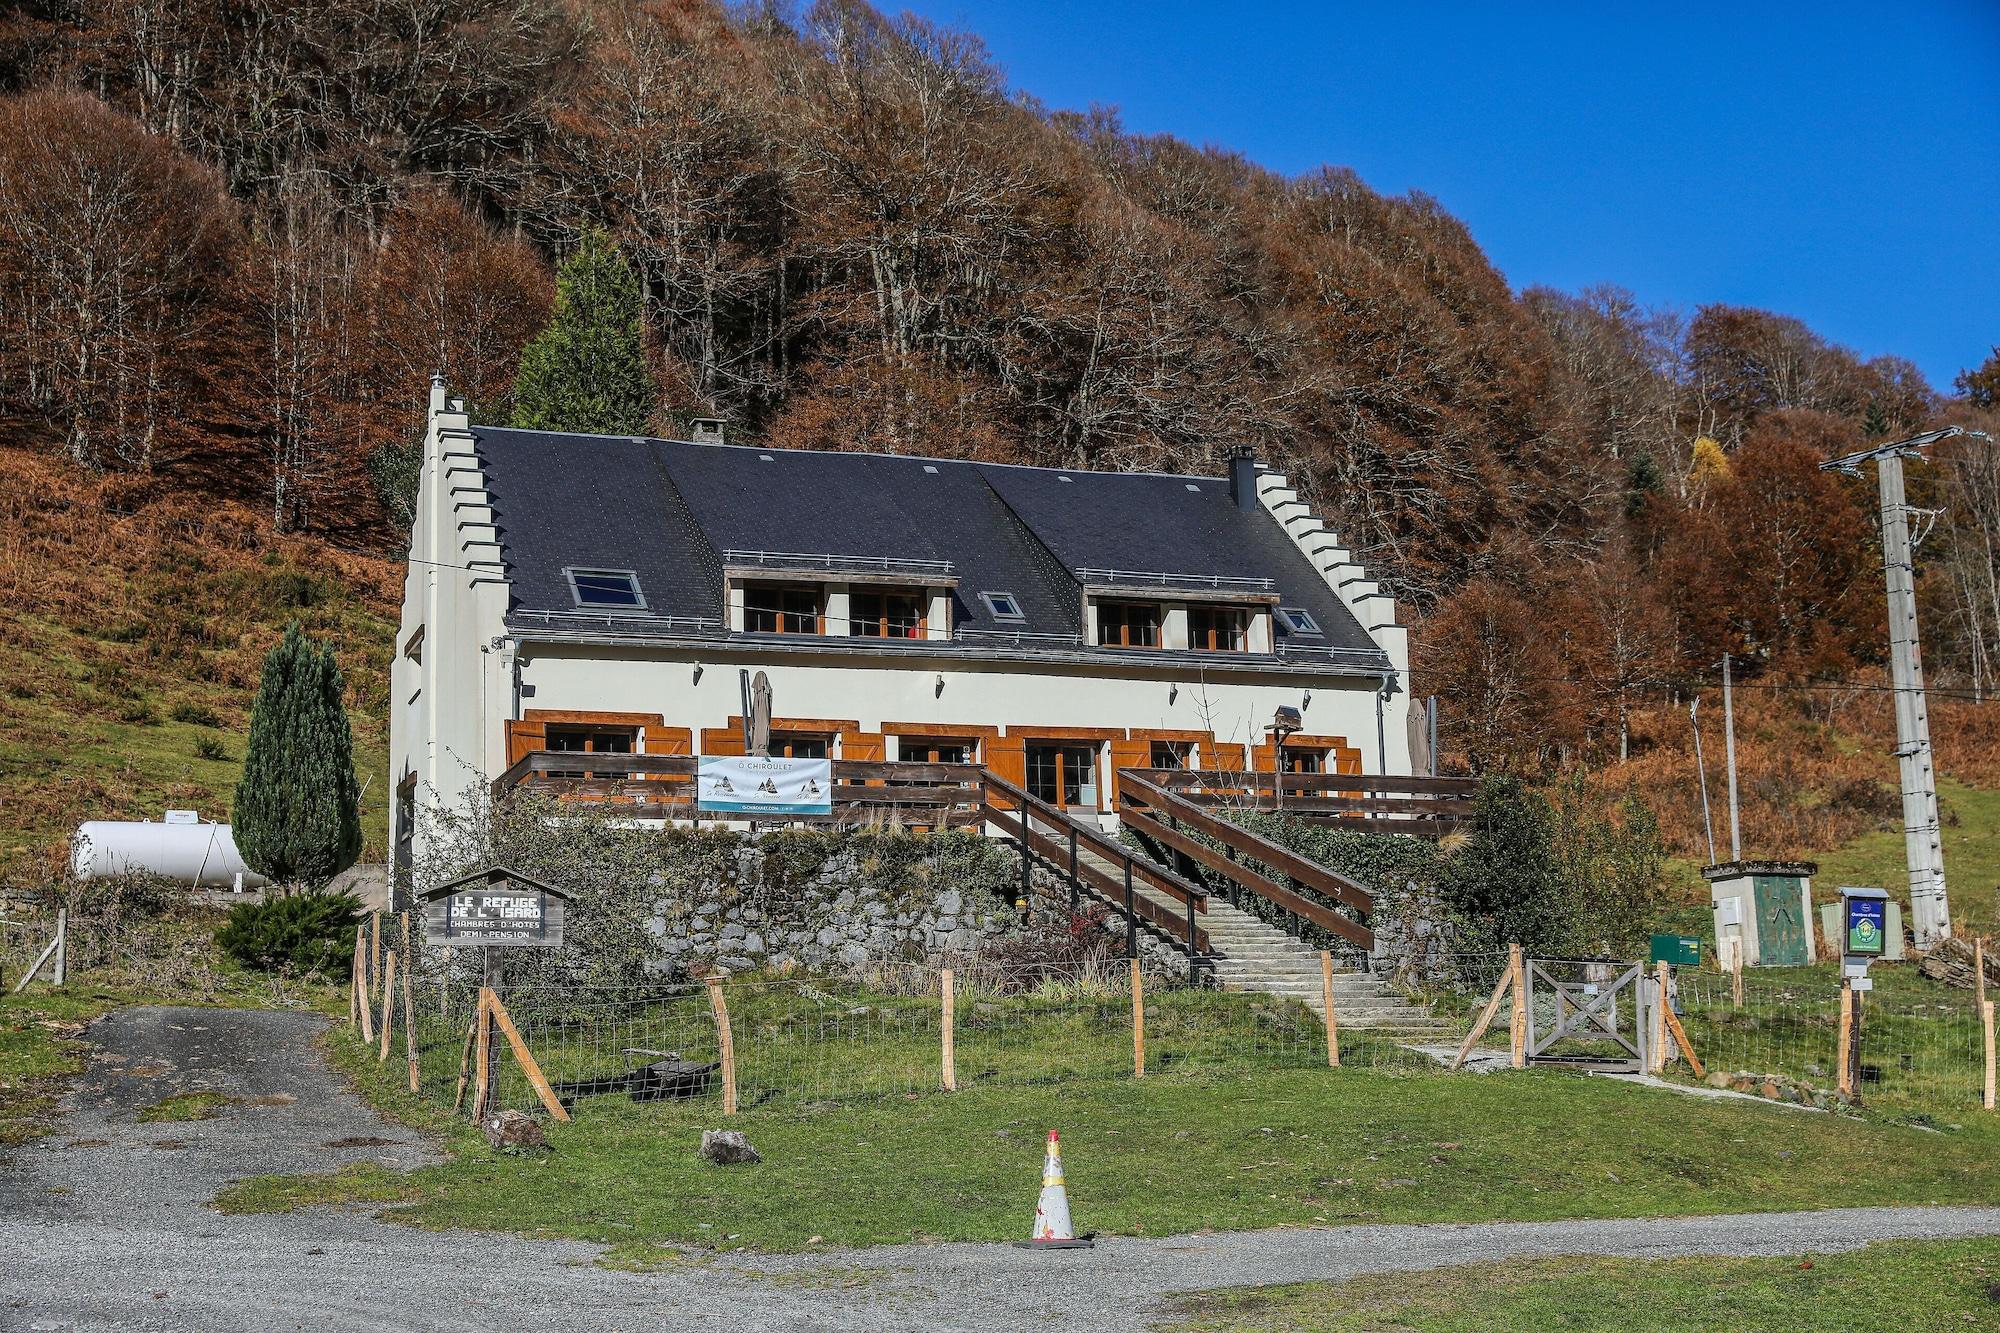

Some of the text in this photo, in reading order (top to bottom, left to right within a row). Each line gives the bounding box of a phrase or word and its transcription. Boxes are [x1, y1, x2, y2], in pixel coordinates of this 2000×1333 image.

[747, 763, 793, 771] CHIROULET
[455, 896, 538, 908] LE REFUGE
[451, 907, 469, 917] DE
[450, 920, 495, 928] CHAMBRES
